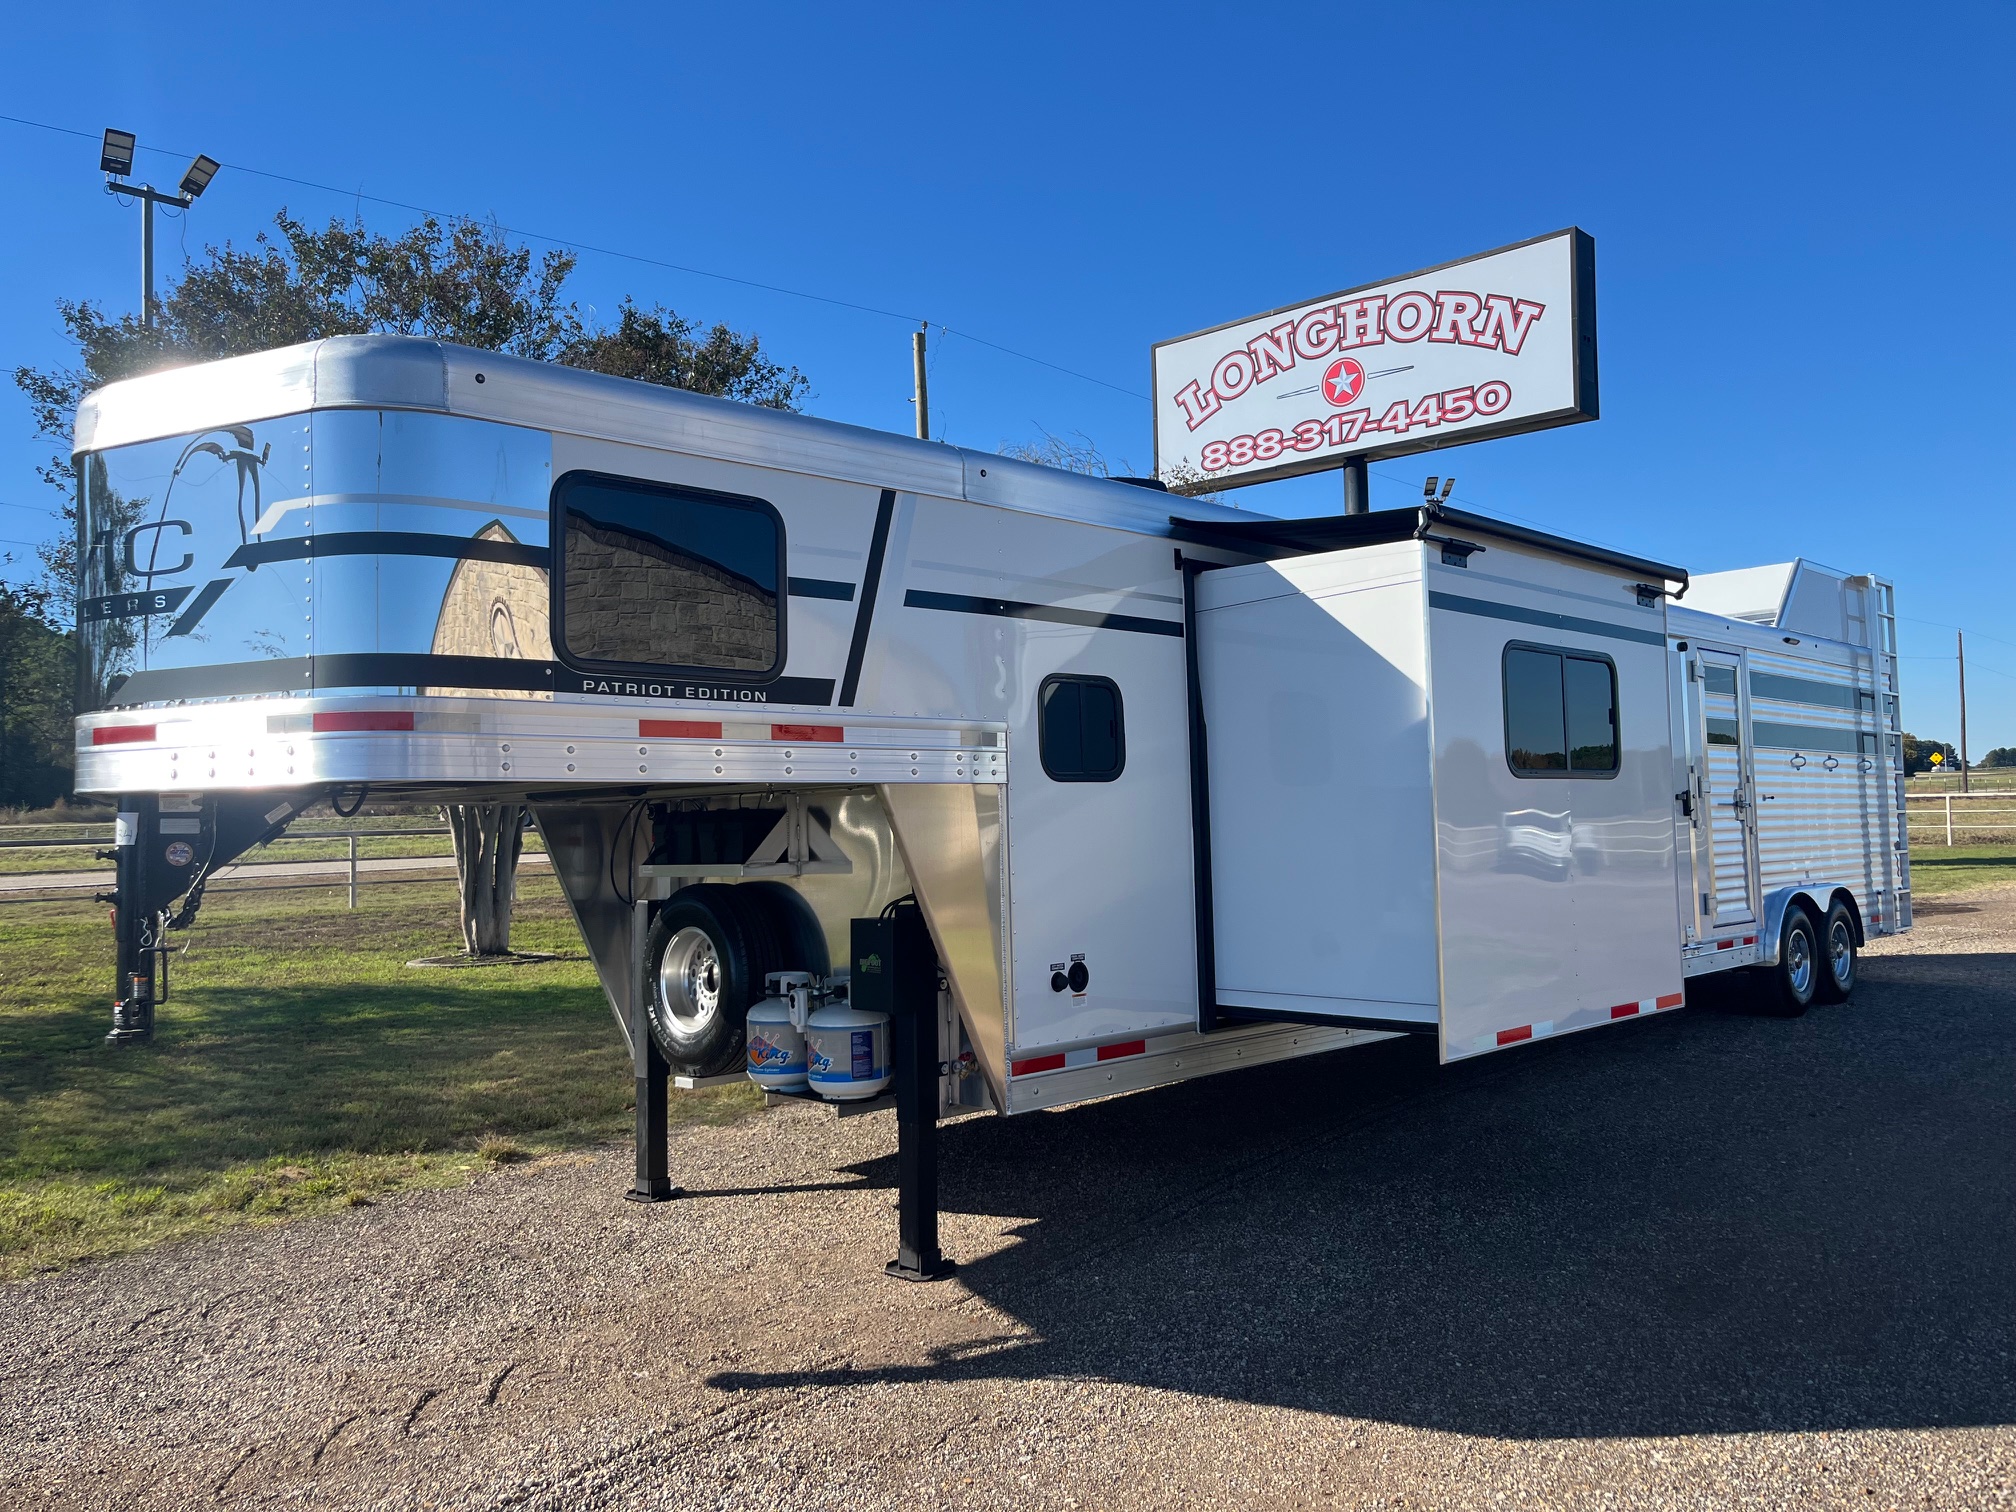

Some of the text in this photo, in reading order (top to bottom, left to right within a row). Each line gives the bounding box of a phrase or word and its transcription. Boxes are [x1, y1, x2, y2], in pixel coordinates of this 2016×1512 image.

[1174, 290, 1546, 432] LONGHORN
[1201, 380, 1512, 471] 888-317-4450
[582, 680, 767, 702] PATRIOT EDITION
